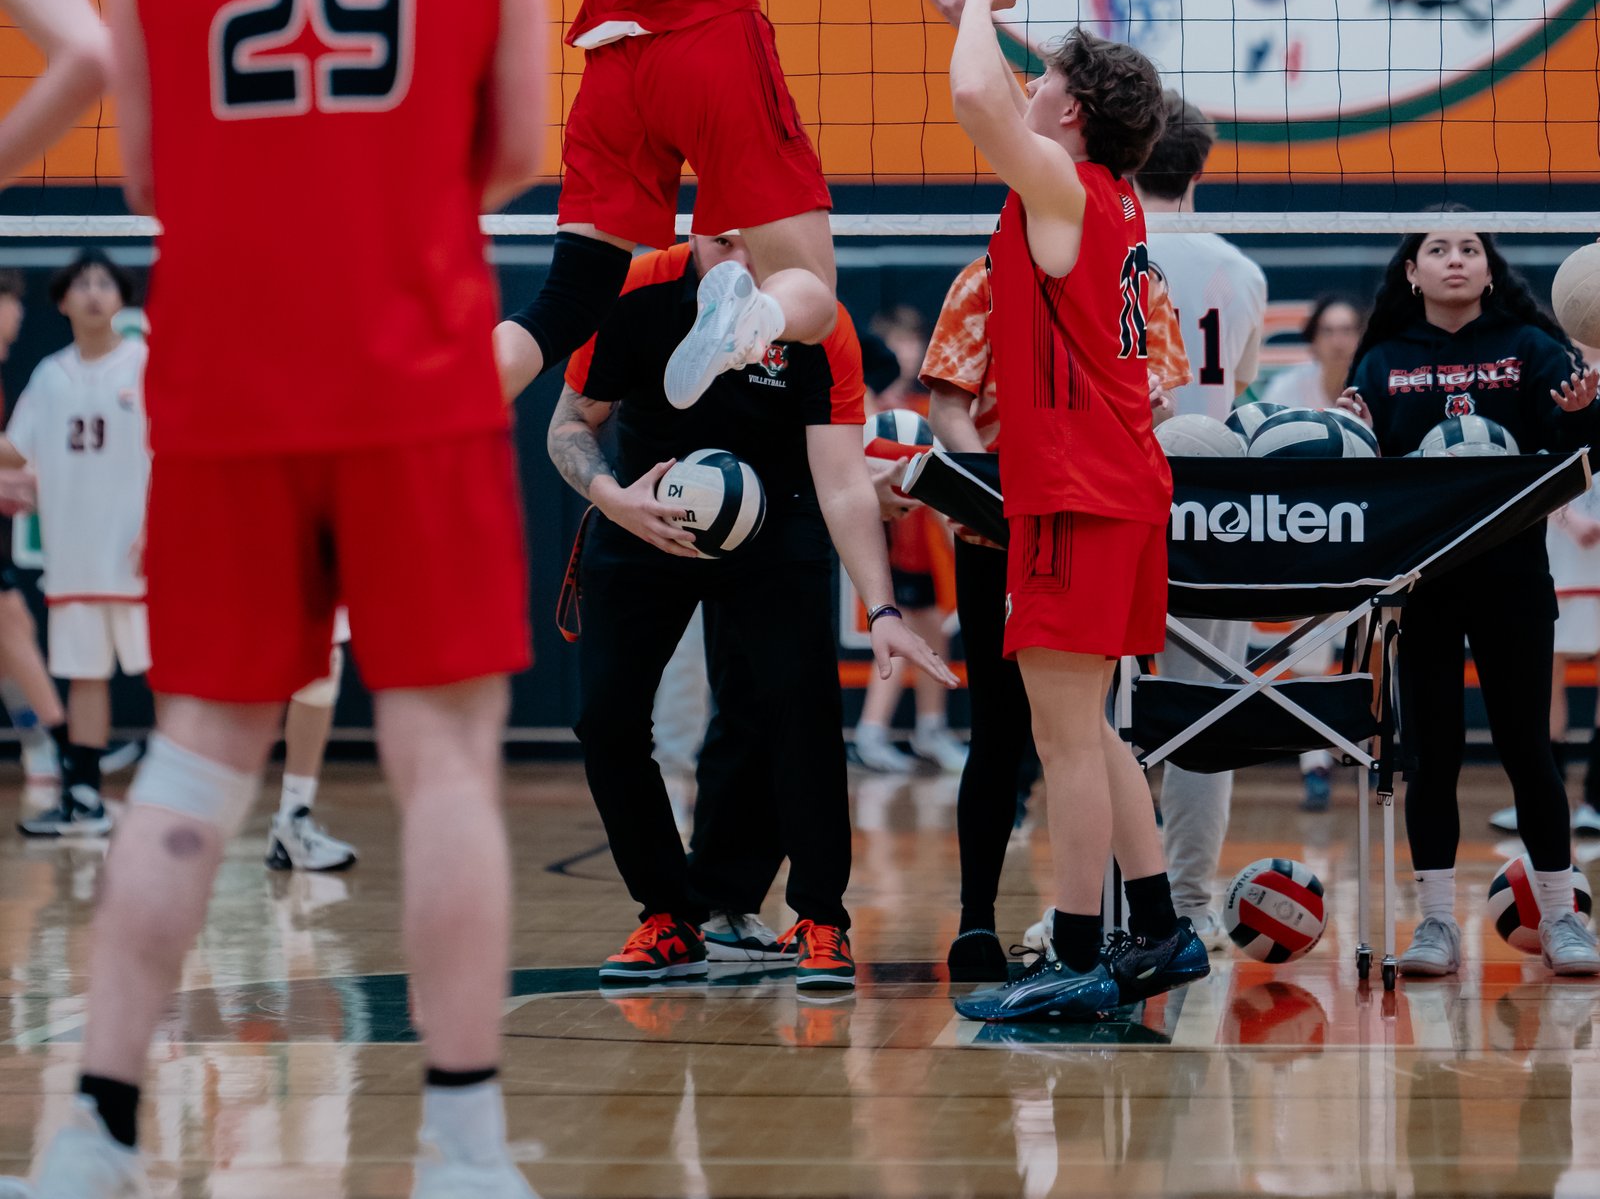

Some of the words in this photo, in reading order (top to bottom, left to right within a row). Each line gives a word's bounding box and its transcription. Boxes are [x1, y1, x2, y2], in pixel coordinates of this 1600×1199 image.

[748, 374, 787, 388] VOLLEYBALL
[1388, 367, 1521, 388] BENGALS
[68, 416, 105, 452] 29
[1170, 494, 1365, 543] molten
